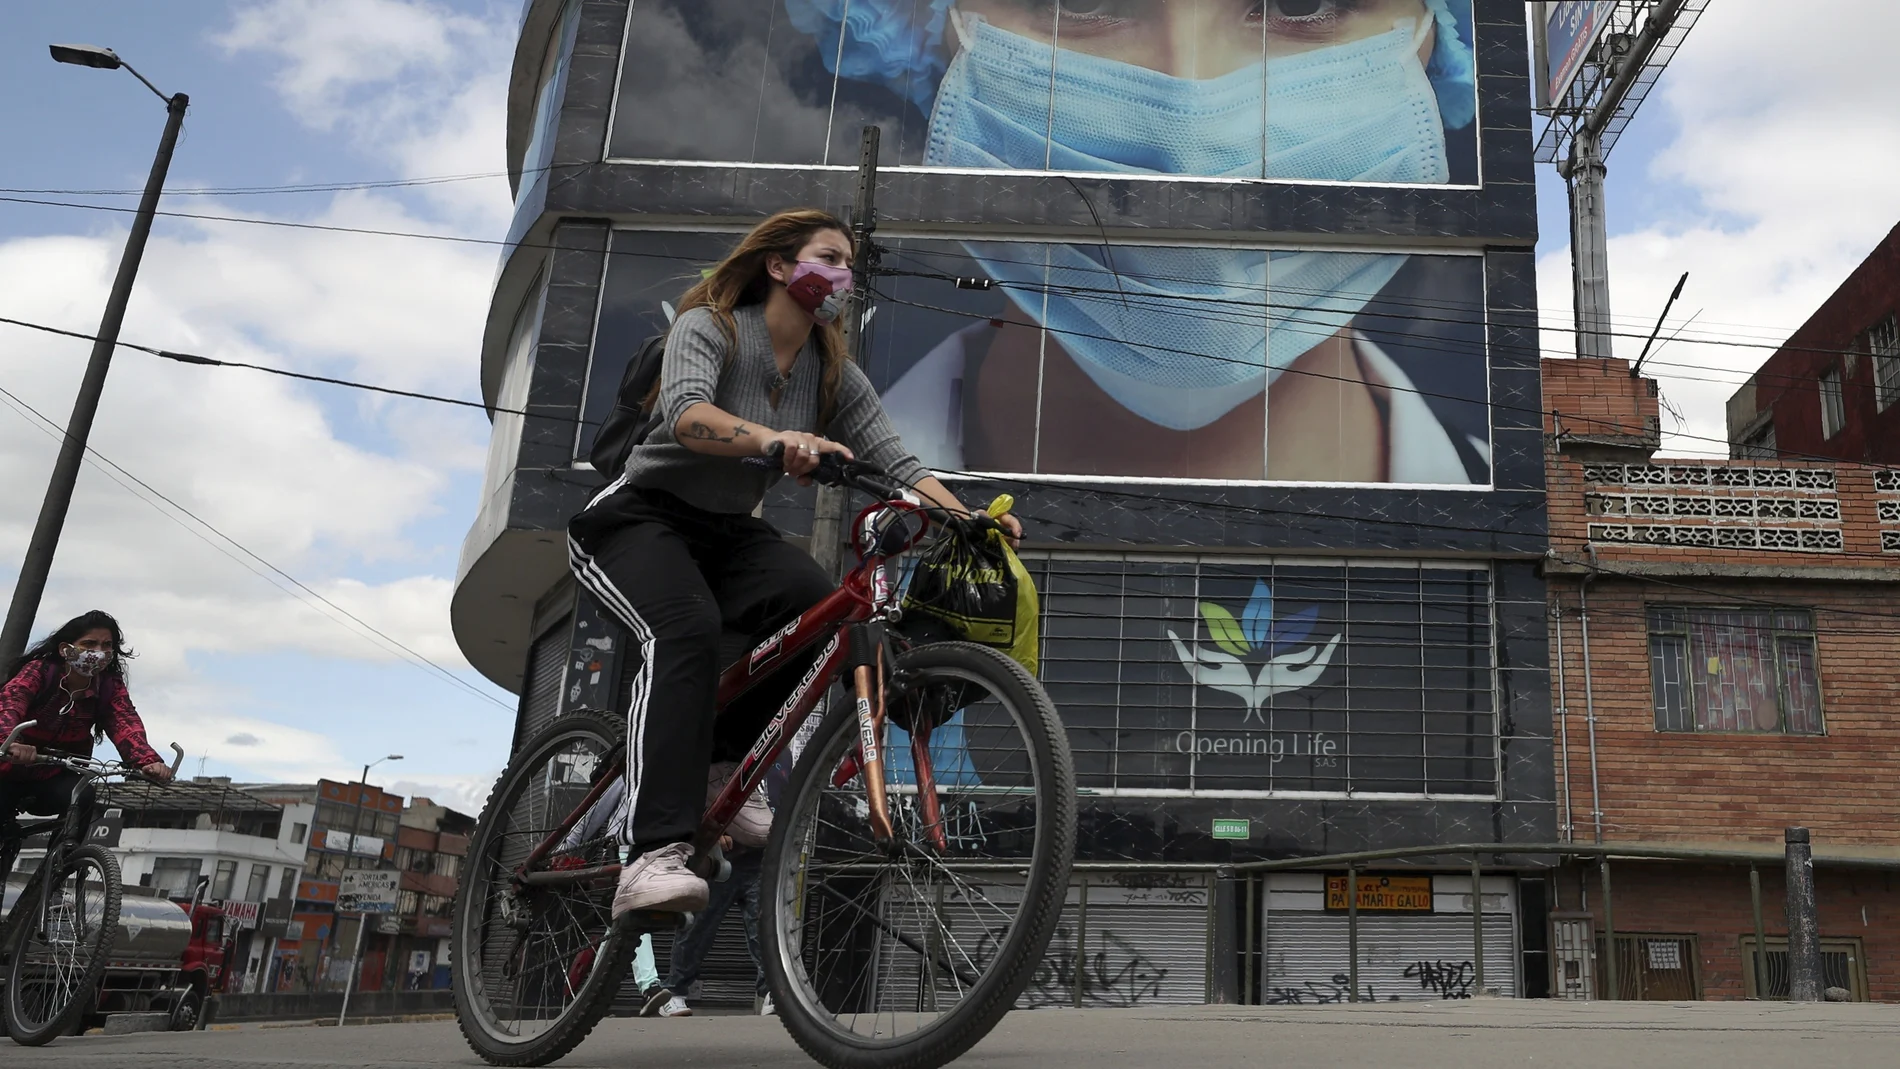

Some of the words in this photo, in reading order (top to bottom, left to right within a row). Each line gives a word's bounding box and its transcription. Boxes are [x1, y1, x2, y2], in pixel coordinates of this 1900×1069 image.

[1176, 731, 1284, 762] Opening
[1294, 733, 1337, 755] Life
[1397, 893, 1429, 908] GALLO
[225, 902, 257, 920] YAMAHA
